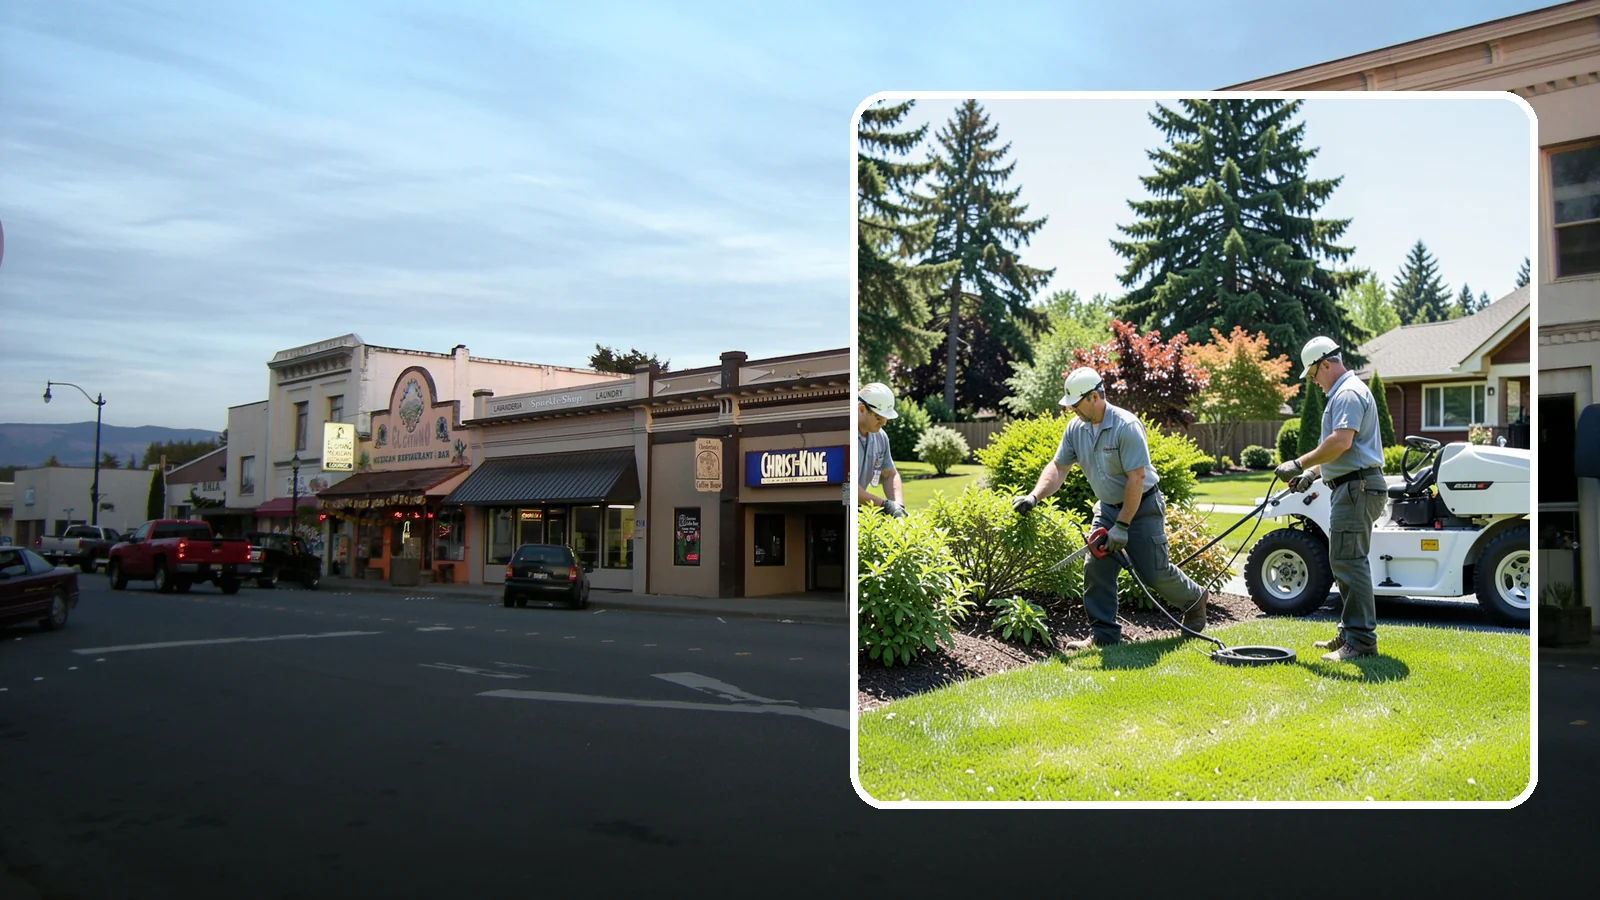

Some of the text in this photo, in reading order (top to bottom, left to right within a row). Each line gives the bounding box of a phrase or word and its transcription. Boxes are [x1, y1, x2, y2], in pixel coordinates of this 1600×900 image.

[595, 388, 623, 399] LAUNDRY
[531, 394, 582, 408] Sparkle Shop
[493, 402, 523, 413] LAVANDERIA
[397, 451, 433, 462] RESTAURANT
[438, 450, 450, 459] BAR
[761, 450, 827, 478] CHRIST KING
